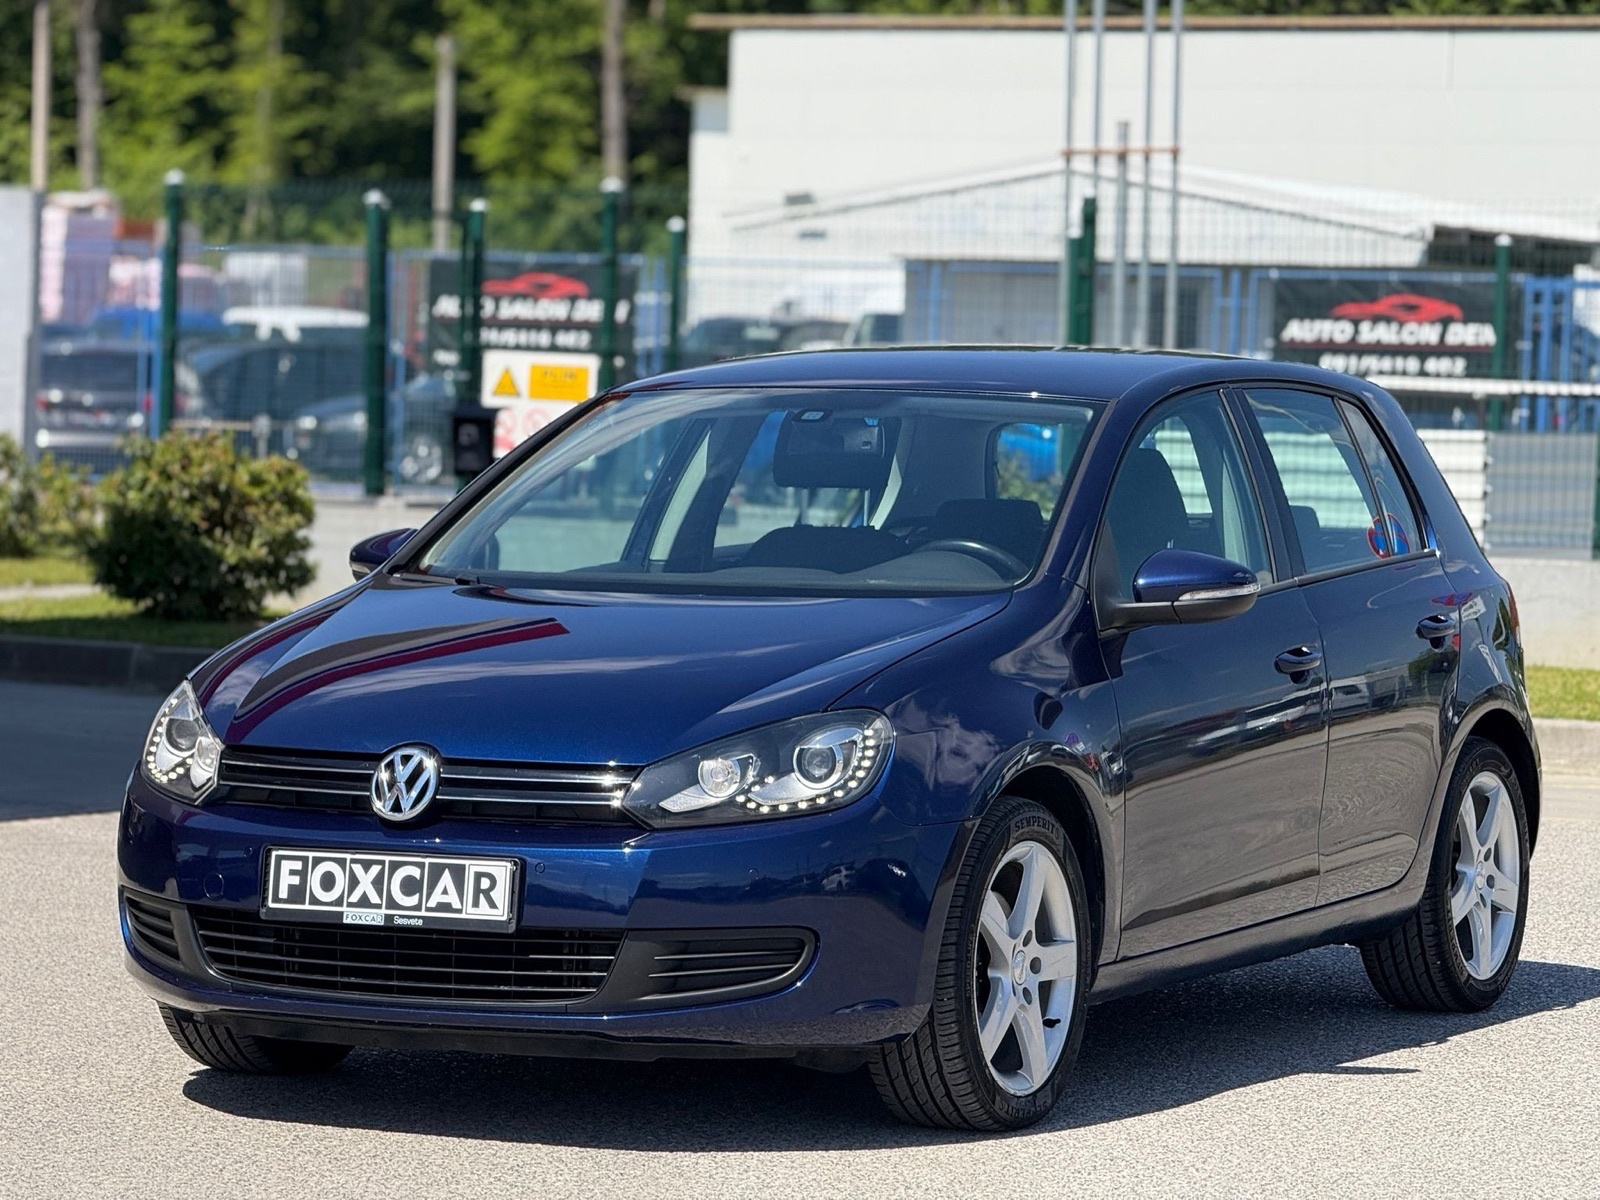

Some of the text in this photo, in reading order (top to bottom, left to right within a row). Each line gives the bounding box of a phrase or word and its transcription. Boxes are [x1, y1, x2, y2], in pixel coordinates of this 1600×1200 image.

[1280, 318, 1355, 343] AUTO
[1356, 320, 1443, 346] SALON
[1014, 815, 1055, 835] SEMPERIT
[278, 858, 501, 911] FOXCAR
[345, 913, 423, 926] FOXCAR Sesvete
